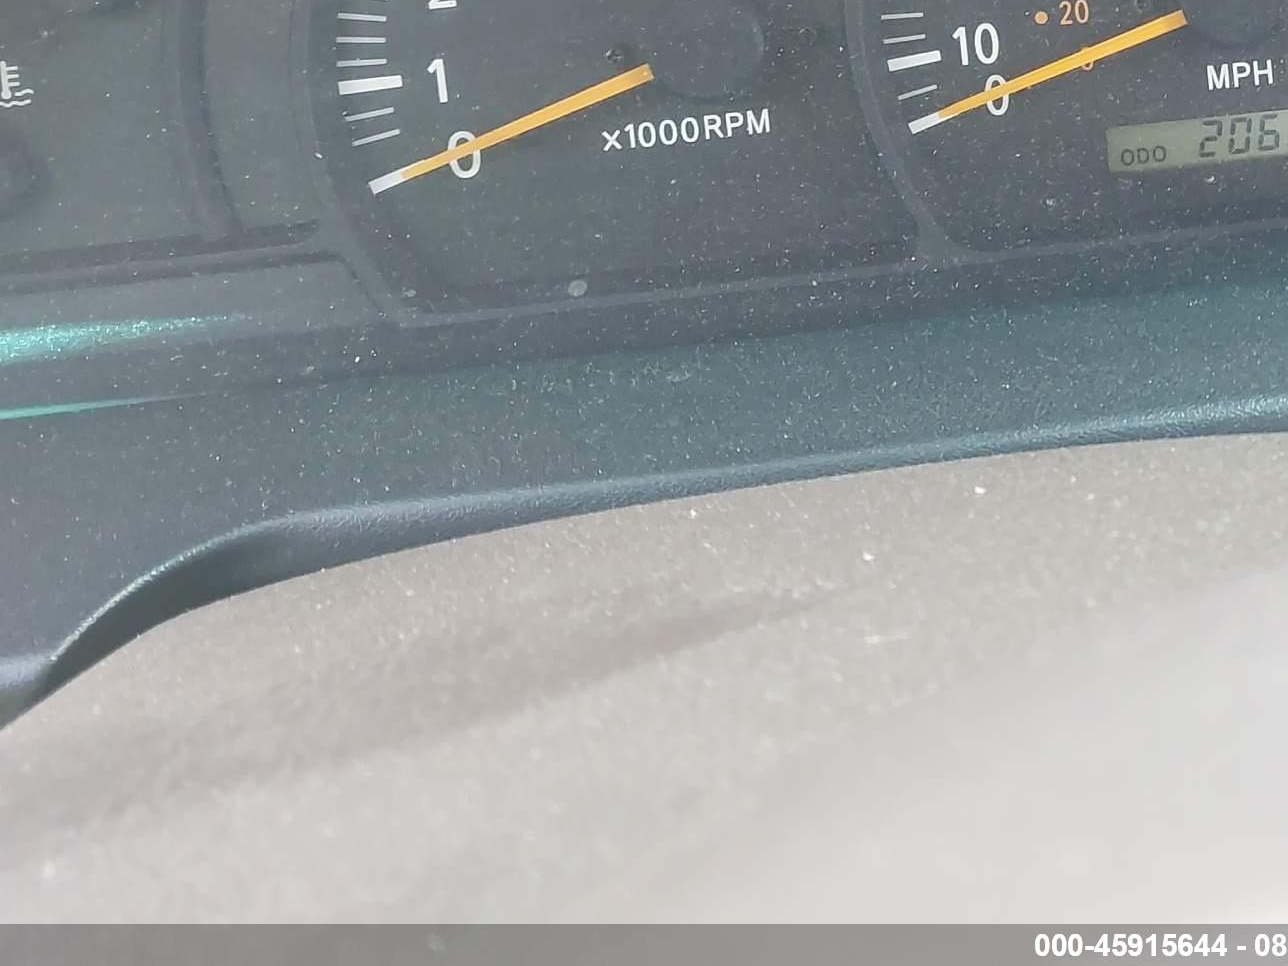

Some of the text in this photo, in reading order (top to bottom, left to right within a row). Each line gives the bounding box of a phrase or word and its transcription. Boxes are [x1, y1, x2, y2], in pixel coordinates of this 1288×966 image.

[1059, 0, 1089, 26] 20
[952, 22, 999, 66] 10
[426, 58, 449, 103] 1
[984, 74, 1010, 117] 0
[1206, 59, 1274, 91] MPH
[447, 130, 482, 179] 0
[1121, 145, 1167, 166] ODO
